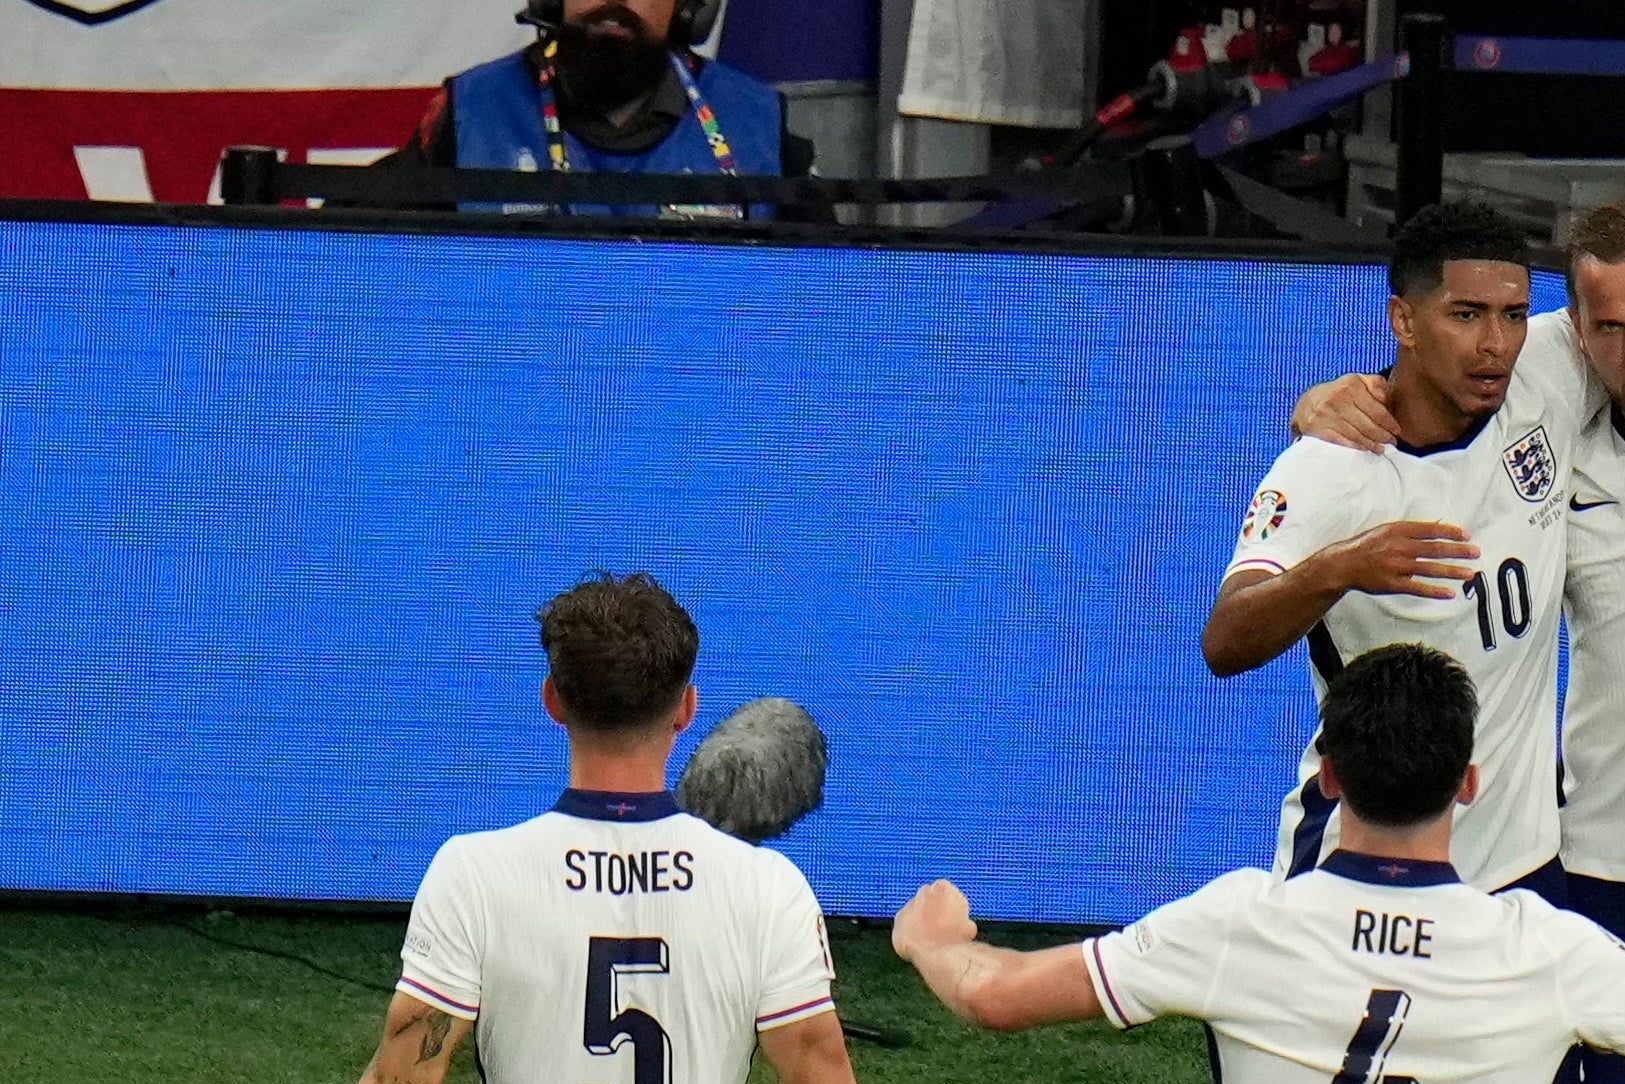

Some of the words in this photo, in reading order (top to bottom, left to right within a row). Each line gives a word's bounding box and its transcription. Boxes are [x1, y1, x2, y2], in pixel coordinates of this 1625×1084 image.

[1462, 557, 1533, 653] 10
[565, 850, 695, 894] STONES
[1351, 909, 1435, 960] RICE
